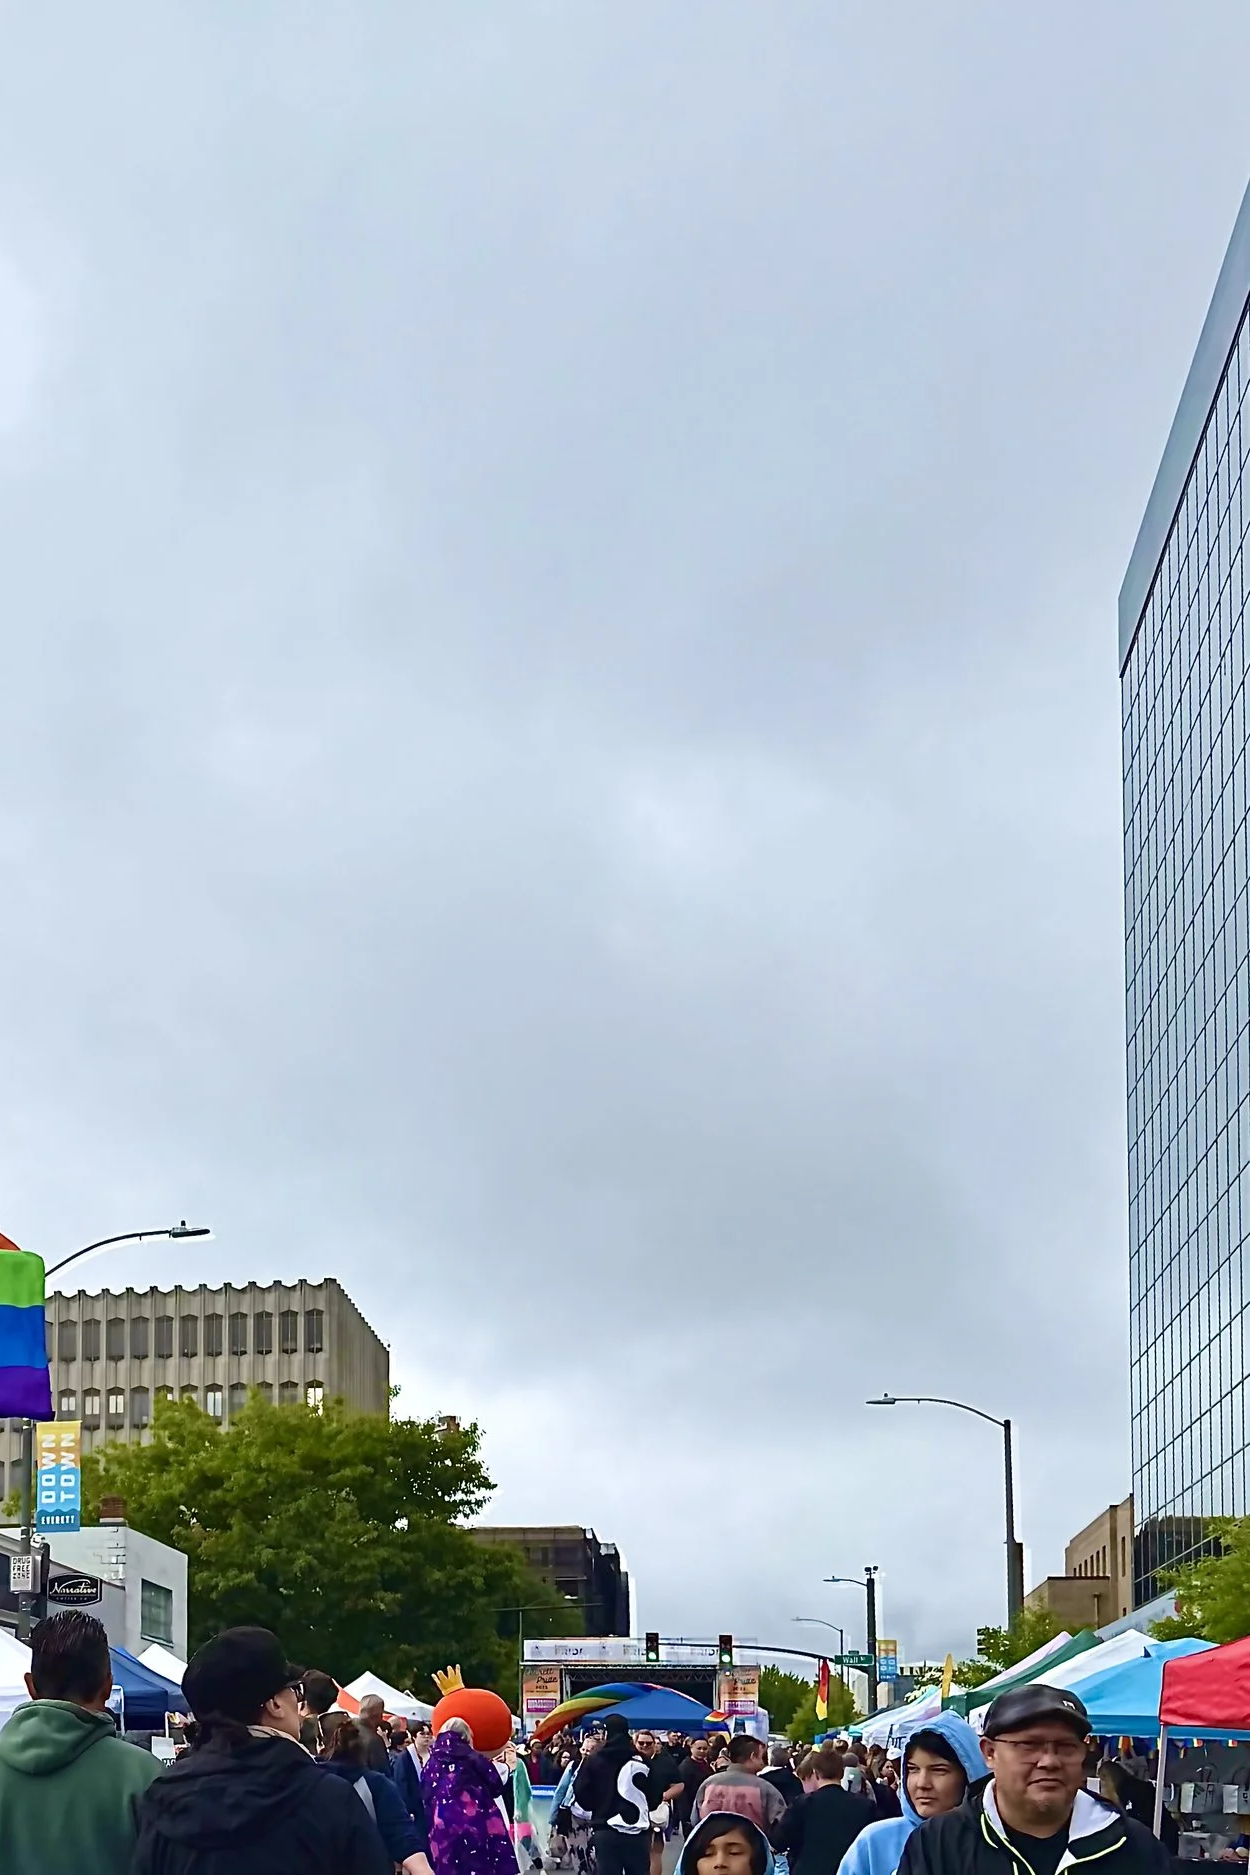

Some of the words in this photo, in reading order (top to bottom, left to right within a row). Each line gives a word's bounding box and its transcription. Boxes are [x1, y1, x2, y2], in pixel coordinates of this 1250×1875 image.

[42, 1433, 56, 1504] DOWN
[60, 1433, 75, 1503] TOWN
[41, 1515, 75, 1525] EVERETT
[12, 1557, 30, 1565] DRUG
[49, 1579, 97, 1594] Narrative
[842, 1656, 859, 1664] Wall
